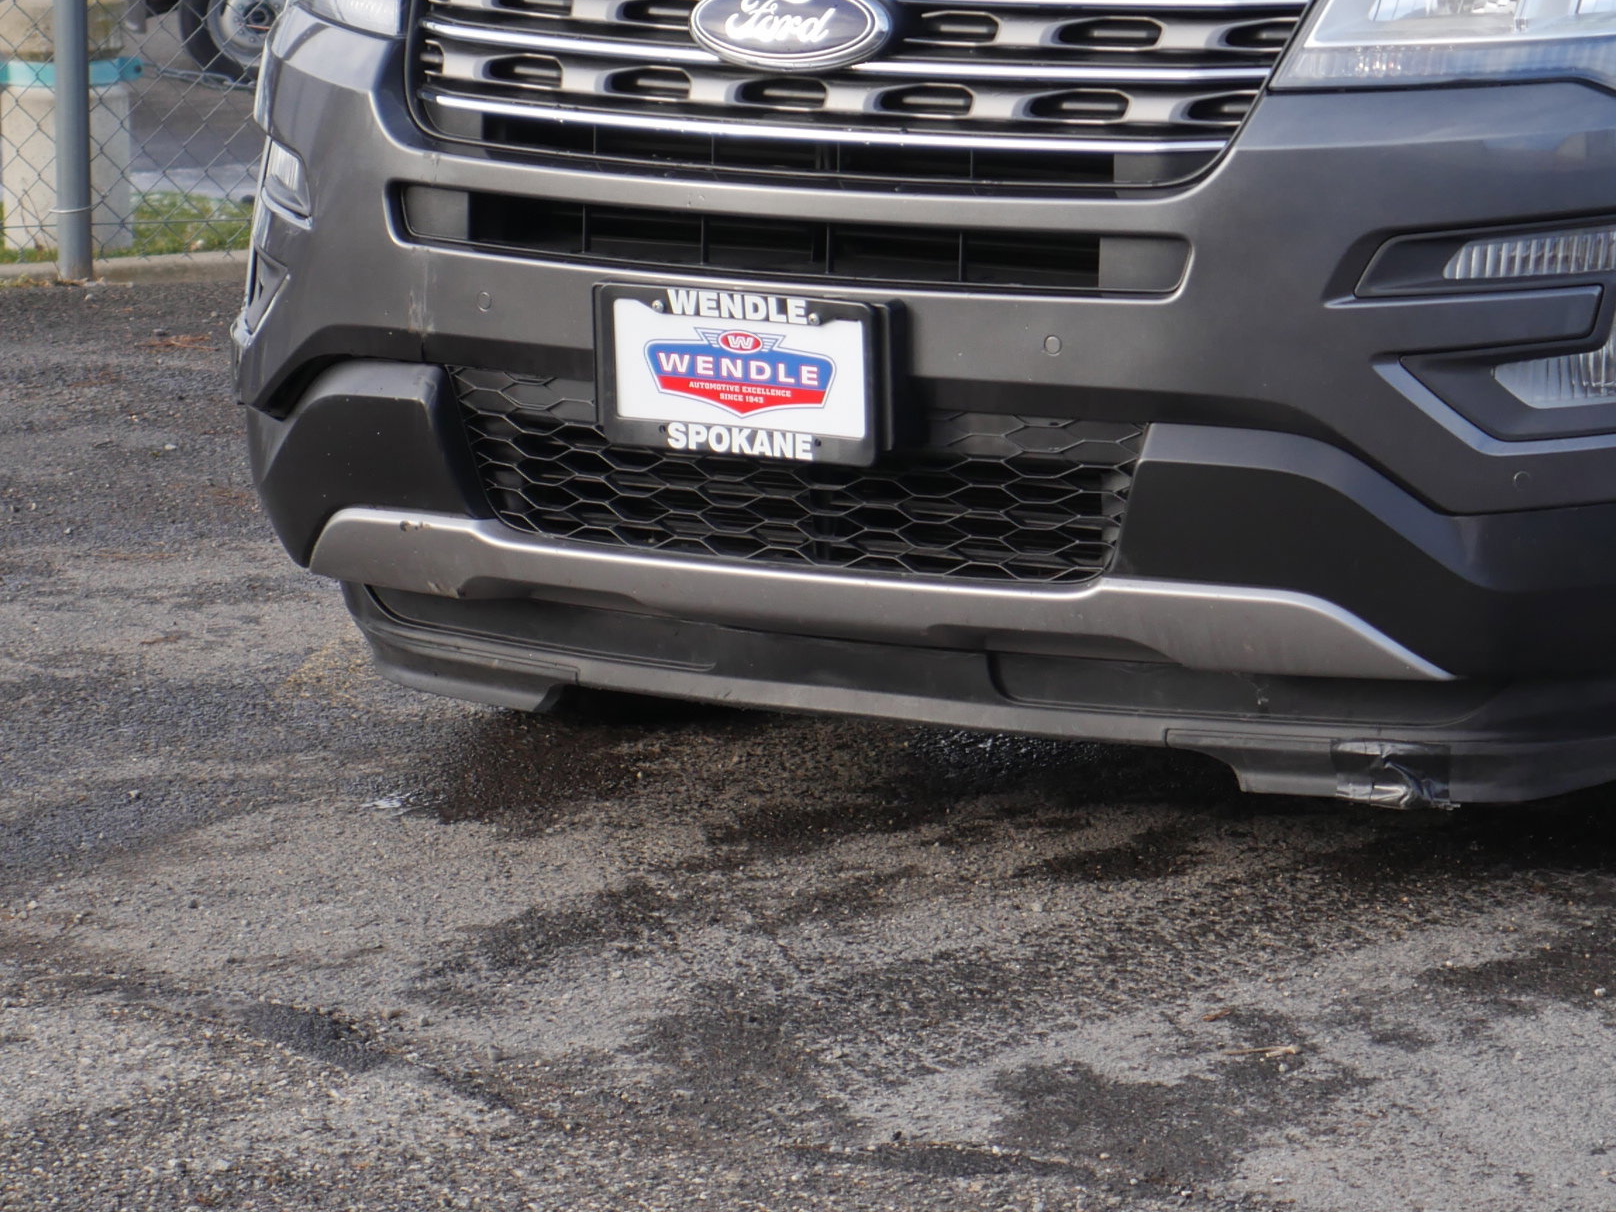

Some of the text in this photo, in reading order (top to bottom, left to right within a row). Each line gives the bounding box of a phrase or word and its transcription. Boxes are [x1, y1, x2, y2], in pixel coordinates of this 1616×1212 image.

[667, 289, 808, 325] WENDLE
[657, 352, 819, 386] WENDLE
[688, 380, 792, 398] AUTOMOTIVE EXCELLENCE
[719, 393, 764, 404] SINCE 1943
[667, 421, 813, 460] SPOKANE
